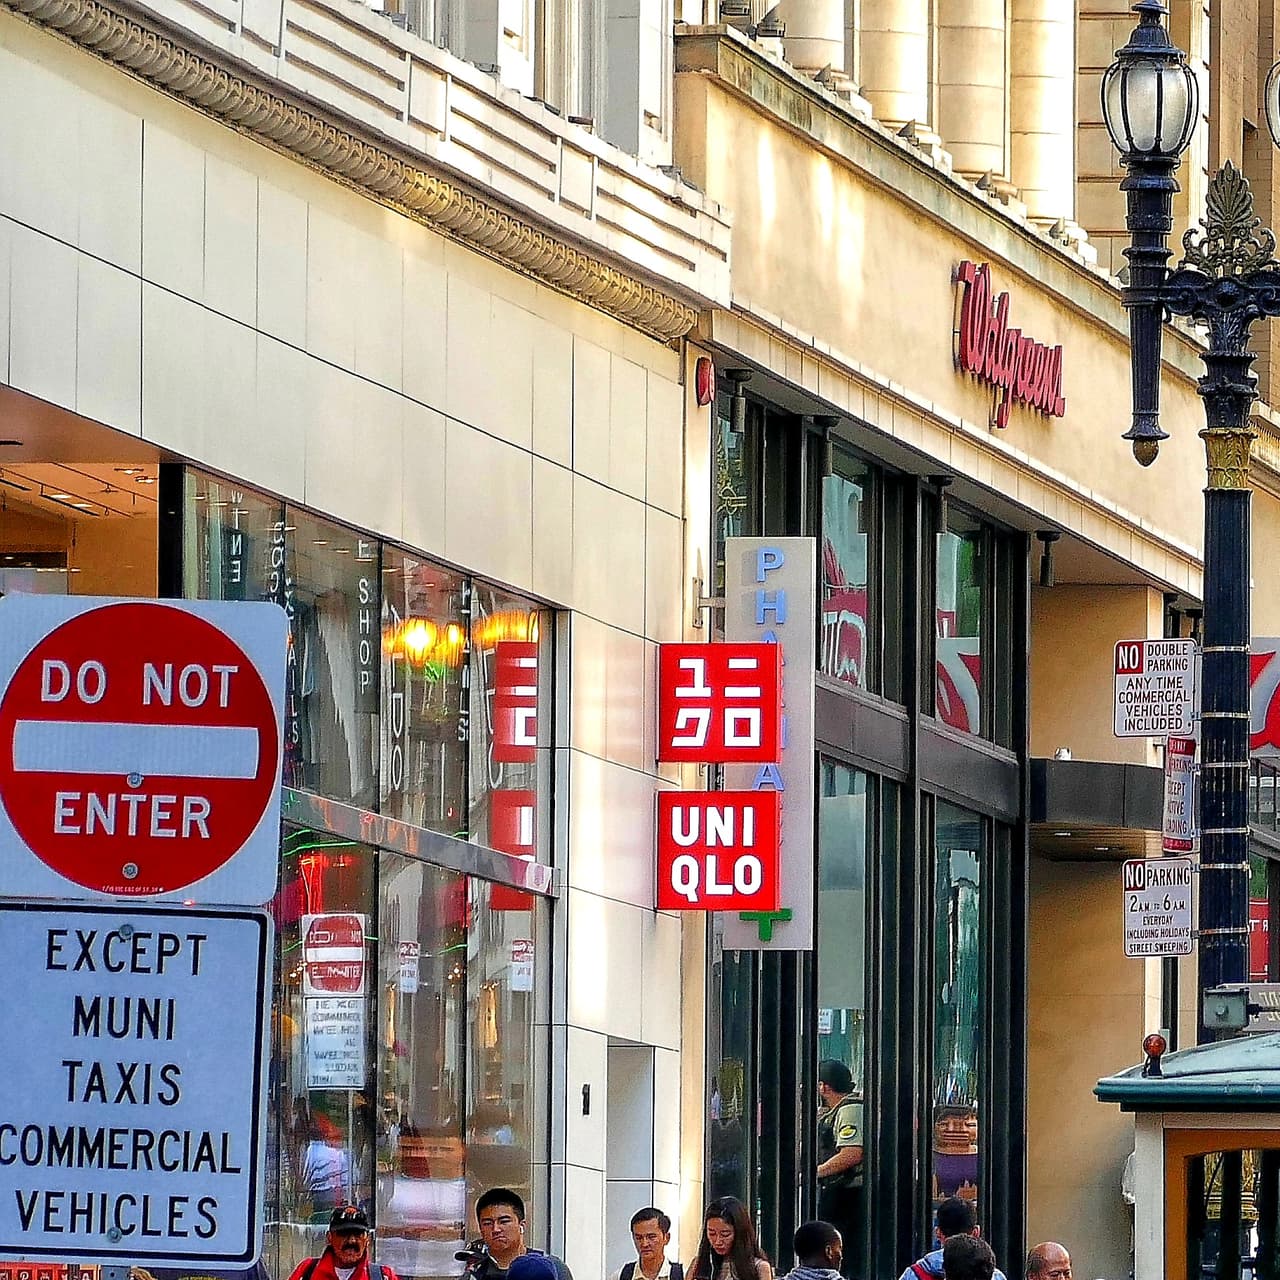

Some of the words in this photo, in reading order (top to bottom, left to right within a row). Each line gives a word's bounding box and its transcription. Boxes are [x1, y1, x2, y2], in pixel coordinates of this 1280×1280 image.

[958, 260, 1065, 429] Walgreens
[359, 578, 371, 695] SHOP
[1119, 645, 1139, 669] NO
[1148, 644, 1188, 656] DOUBLE
[41, 660, 106, 704] DO
[142, 662, 238, 708] NOT
[675, 658, 761, 697] ユニ
[1127, 677, 1151, 690] ANY
[1157, 677, 1183, 689] TIME
[1148, 658, 1188, 671] PARKING
[1119, 690, 1190, 703] COMMERCIAL
[1126, 704, 1182, 717] VEHICLES
[671, 707, 761, 748] クロ
[1125, 718, 1182, 731] INCLUDED
[54, 791, 211, 838] ENTER
[671, 806, 753, 847] UNI
[670, 854, 762, 903] QLO
[1126, 864, 1144, 888] NO
[1147, 868, 1190, 887] PARKING
[1130, 895, 1138, 912] 2
[1163, 894, 1171, 911] 6
[1143, 915, 1173, 926] EVERYDAY
[46, 929, 207, 976] EXCEPT
[1127, 929, 1159, 939] INCLUDING
[1160, 927, 1190, 938] HOLIDAYS
[1129, 943, 1152, 953] STREET
[1155, 942, 1188, 952] SWEEPING
[72, 996, 175, 1041] MUNI
[62, 1060, 181, 1106] TAXIS
[0, 1124, 241, 1174] COMMERCIAL
[15, 1189, 218, 1239] VEHICLES
